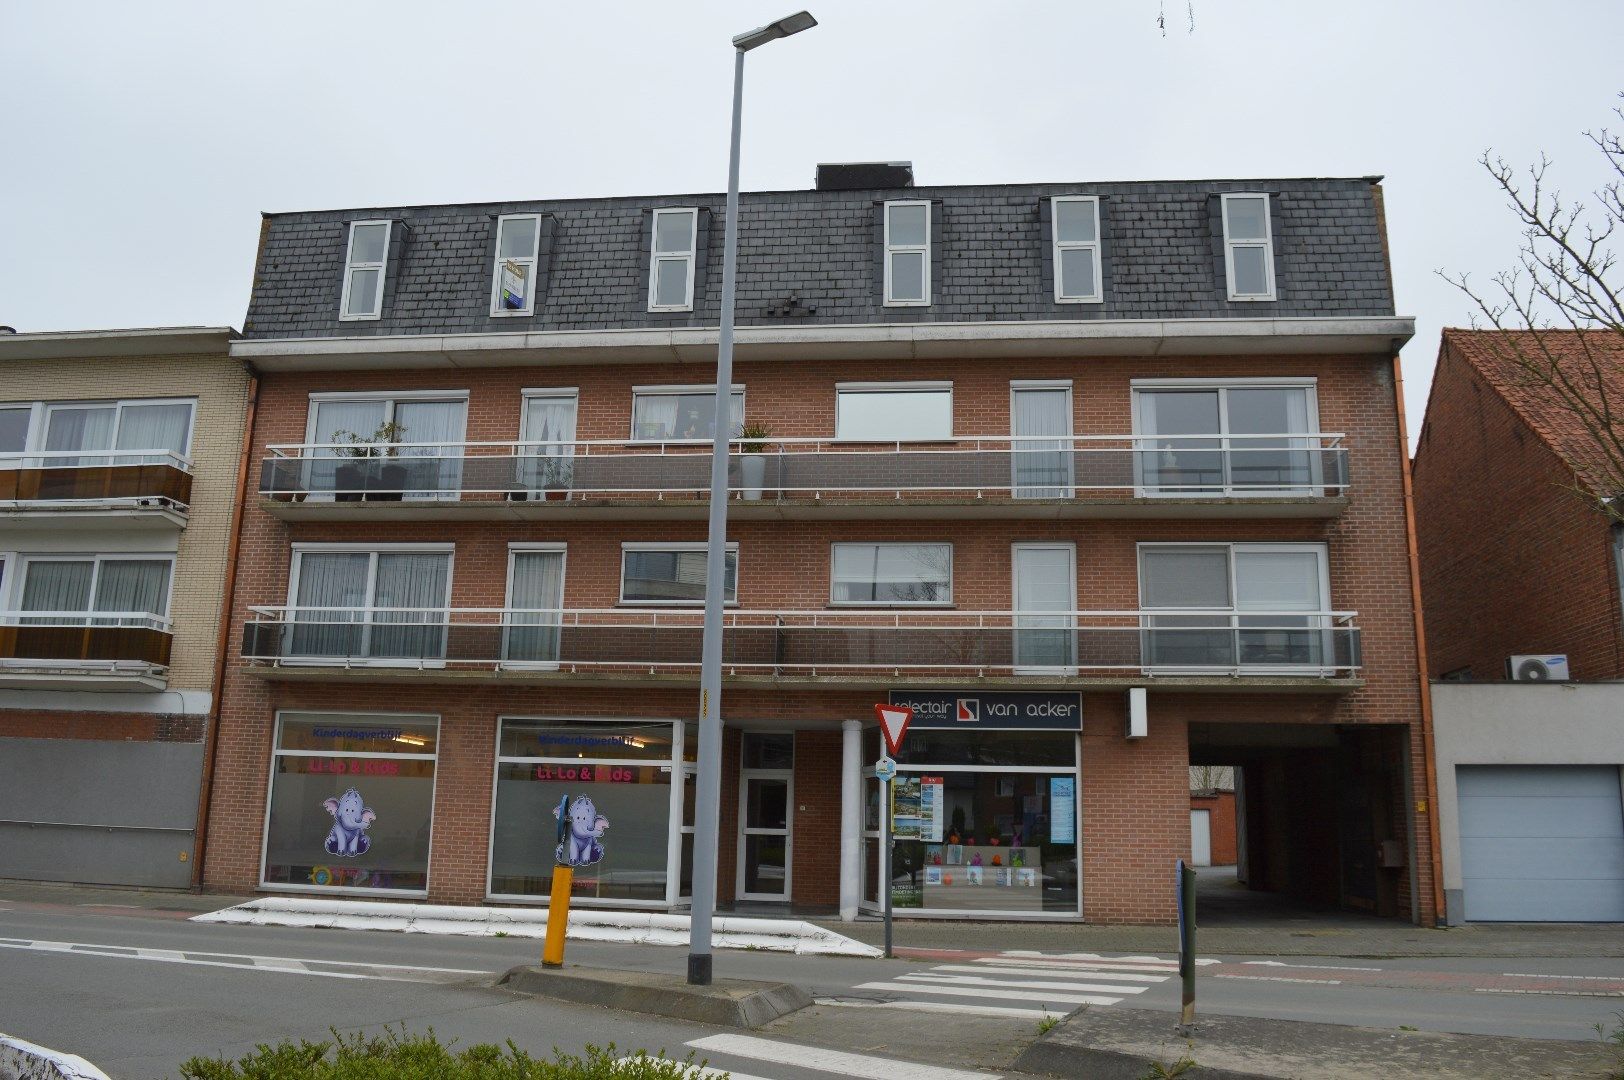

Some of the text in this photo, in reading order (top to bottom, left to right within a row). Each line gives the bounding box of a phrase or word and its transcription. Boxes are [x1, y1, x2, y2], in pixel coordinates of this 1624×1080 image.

[986, 703, 1018, 716] van
[1026, 700, 1077, 717] acker
[313, 728, 402, 741] Kinderdagverblijf
[538, 735, 635, 748] Kinderdagverblijf
[580, 767, 591, 780] &
